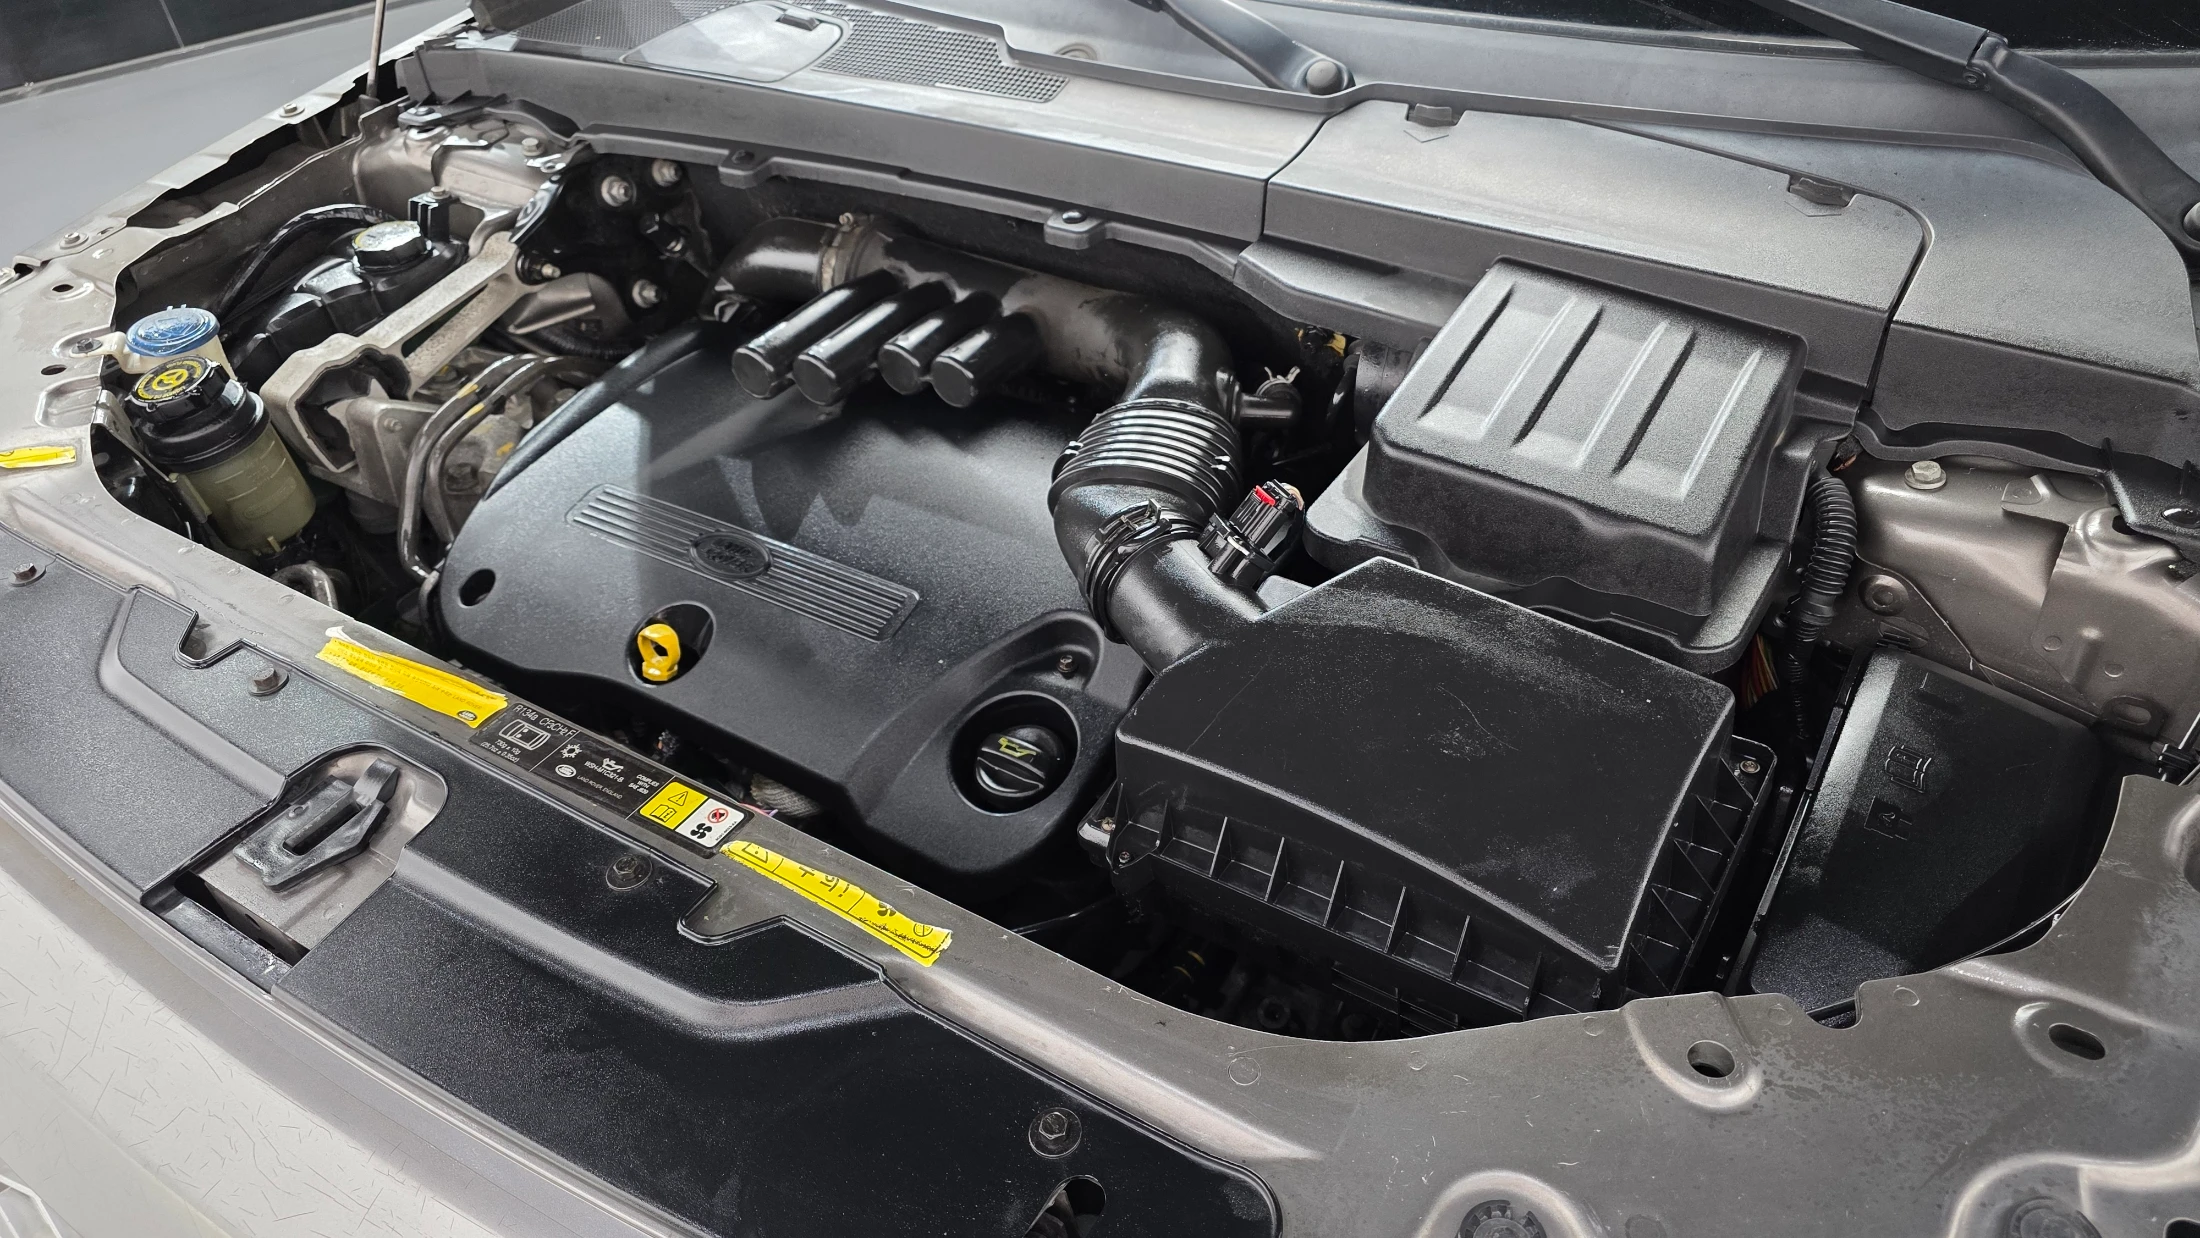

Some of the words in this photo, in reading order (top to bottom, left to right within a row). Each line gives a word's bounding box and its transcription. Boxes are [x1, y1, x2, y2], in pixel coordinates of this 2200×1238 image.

[512, 704, 539, 721] R134a
[576, 775, 590, 783] LAND
[602, 787, 623, 799] ENGLAND
[636, 774, 660, 787] COMPLIES
